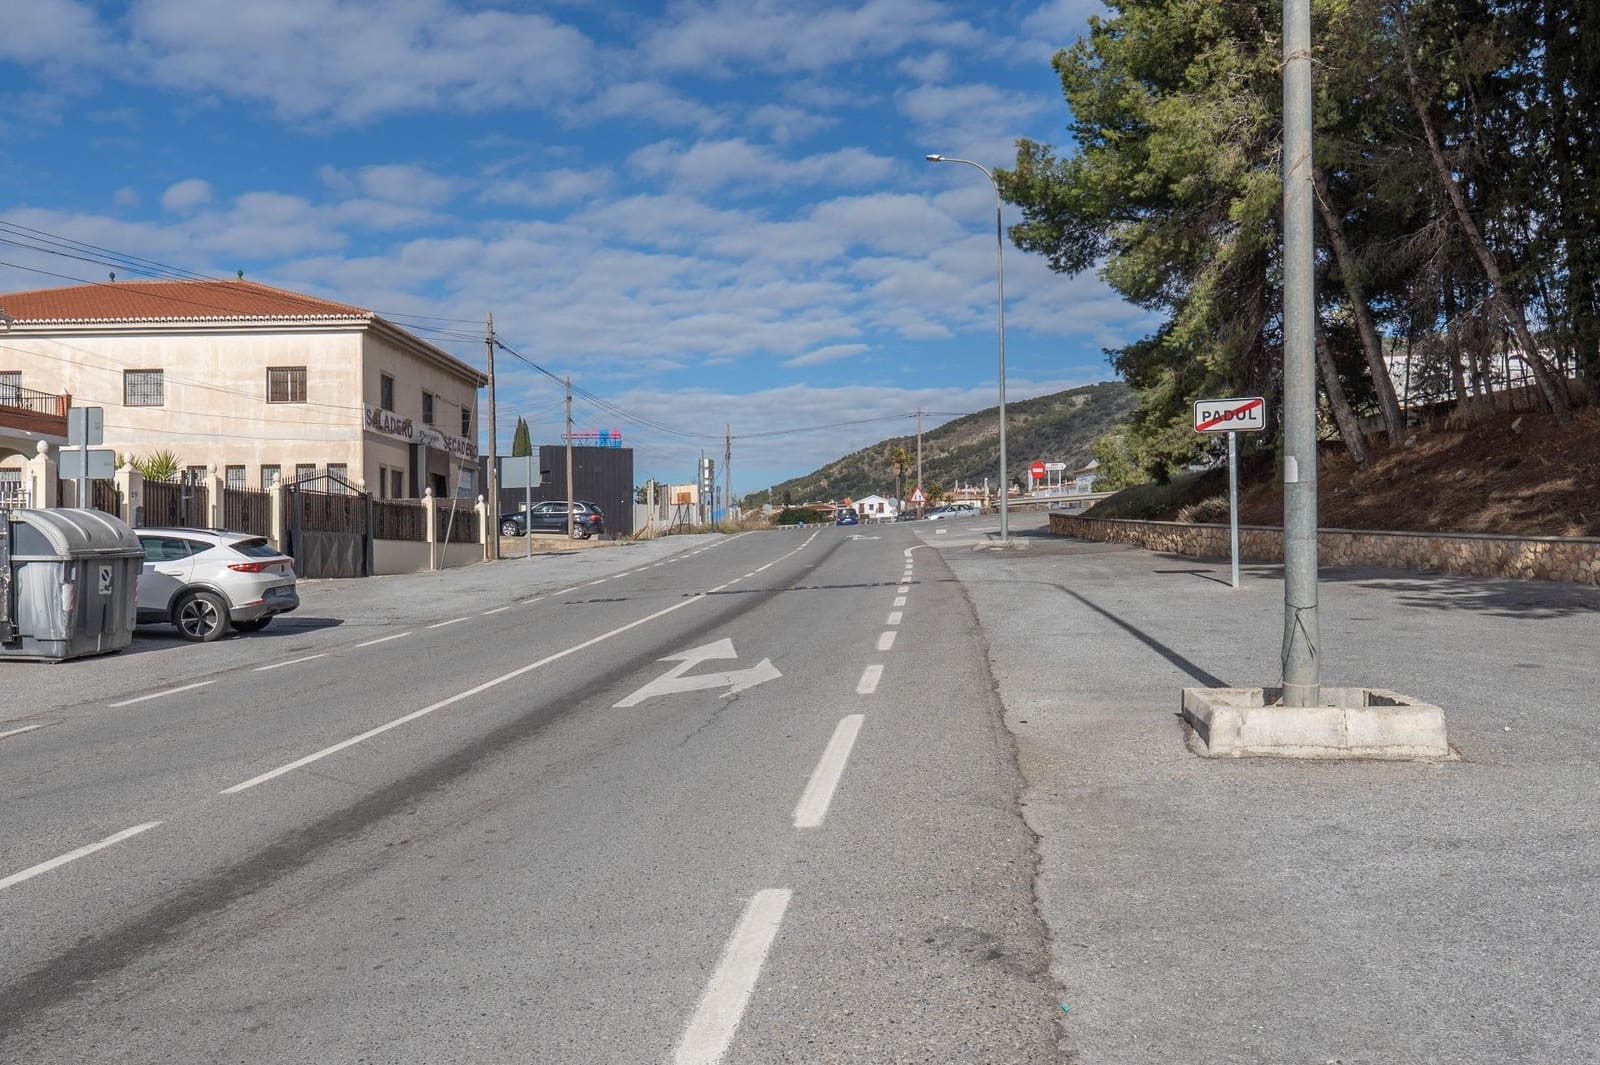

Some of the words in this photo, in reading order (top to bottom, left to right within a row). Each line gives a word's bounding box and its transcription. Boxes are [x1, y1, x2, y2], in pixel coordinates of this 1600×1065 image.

[1202, 407, 1256, 422] PADUL
[365, 408, 413, 438] SALADERO
[443, 435, 478, 458] SECADERO
